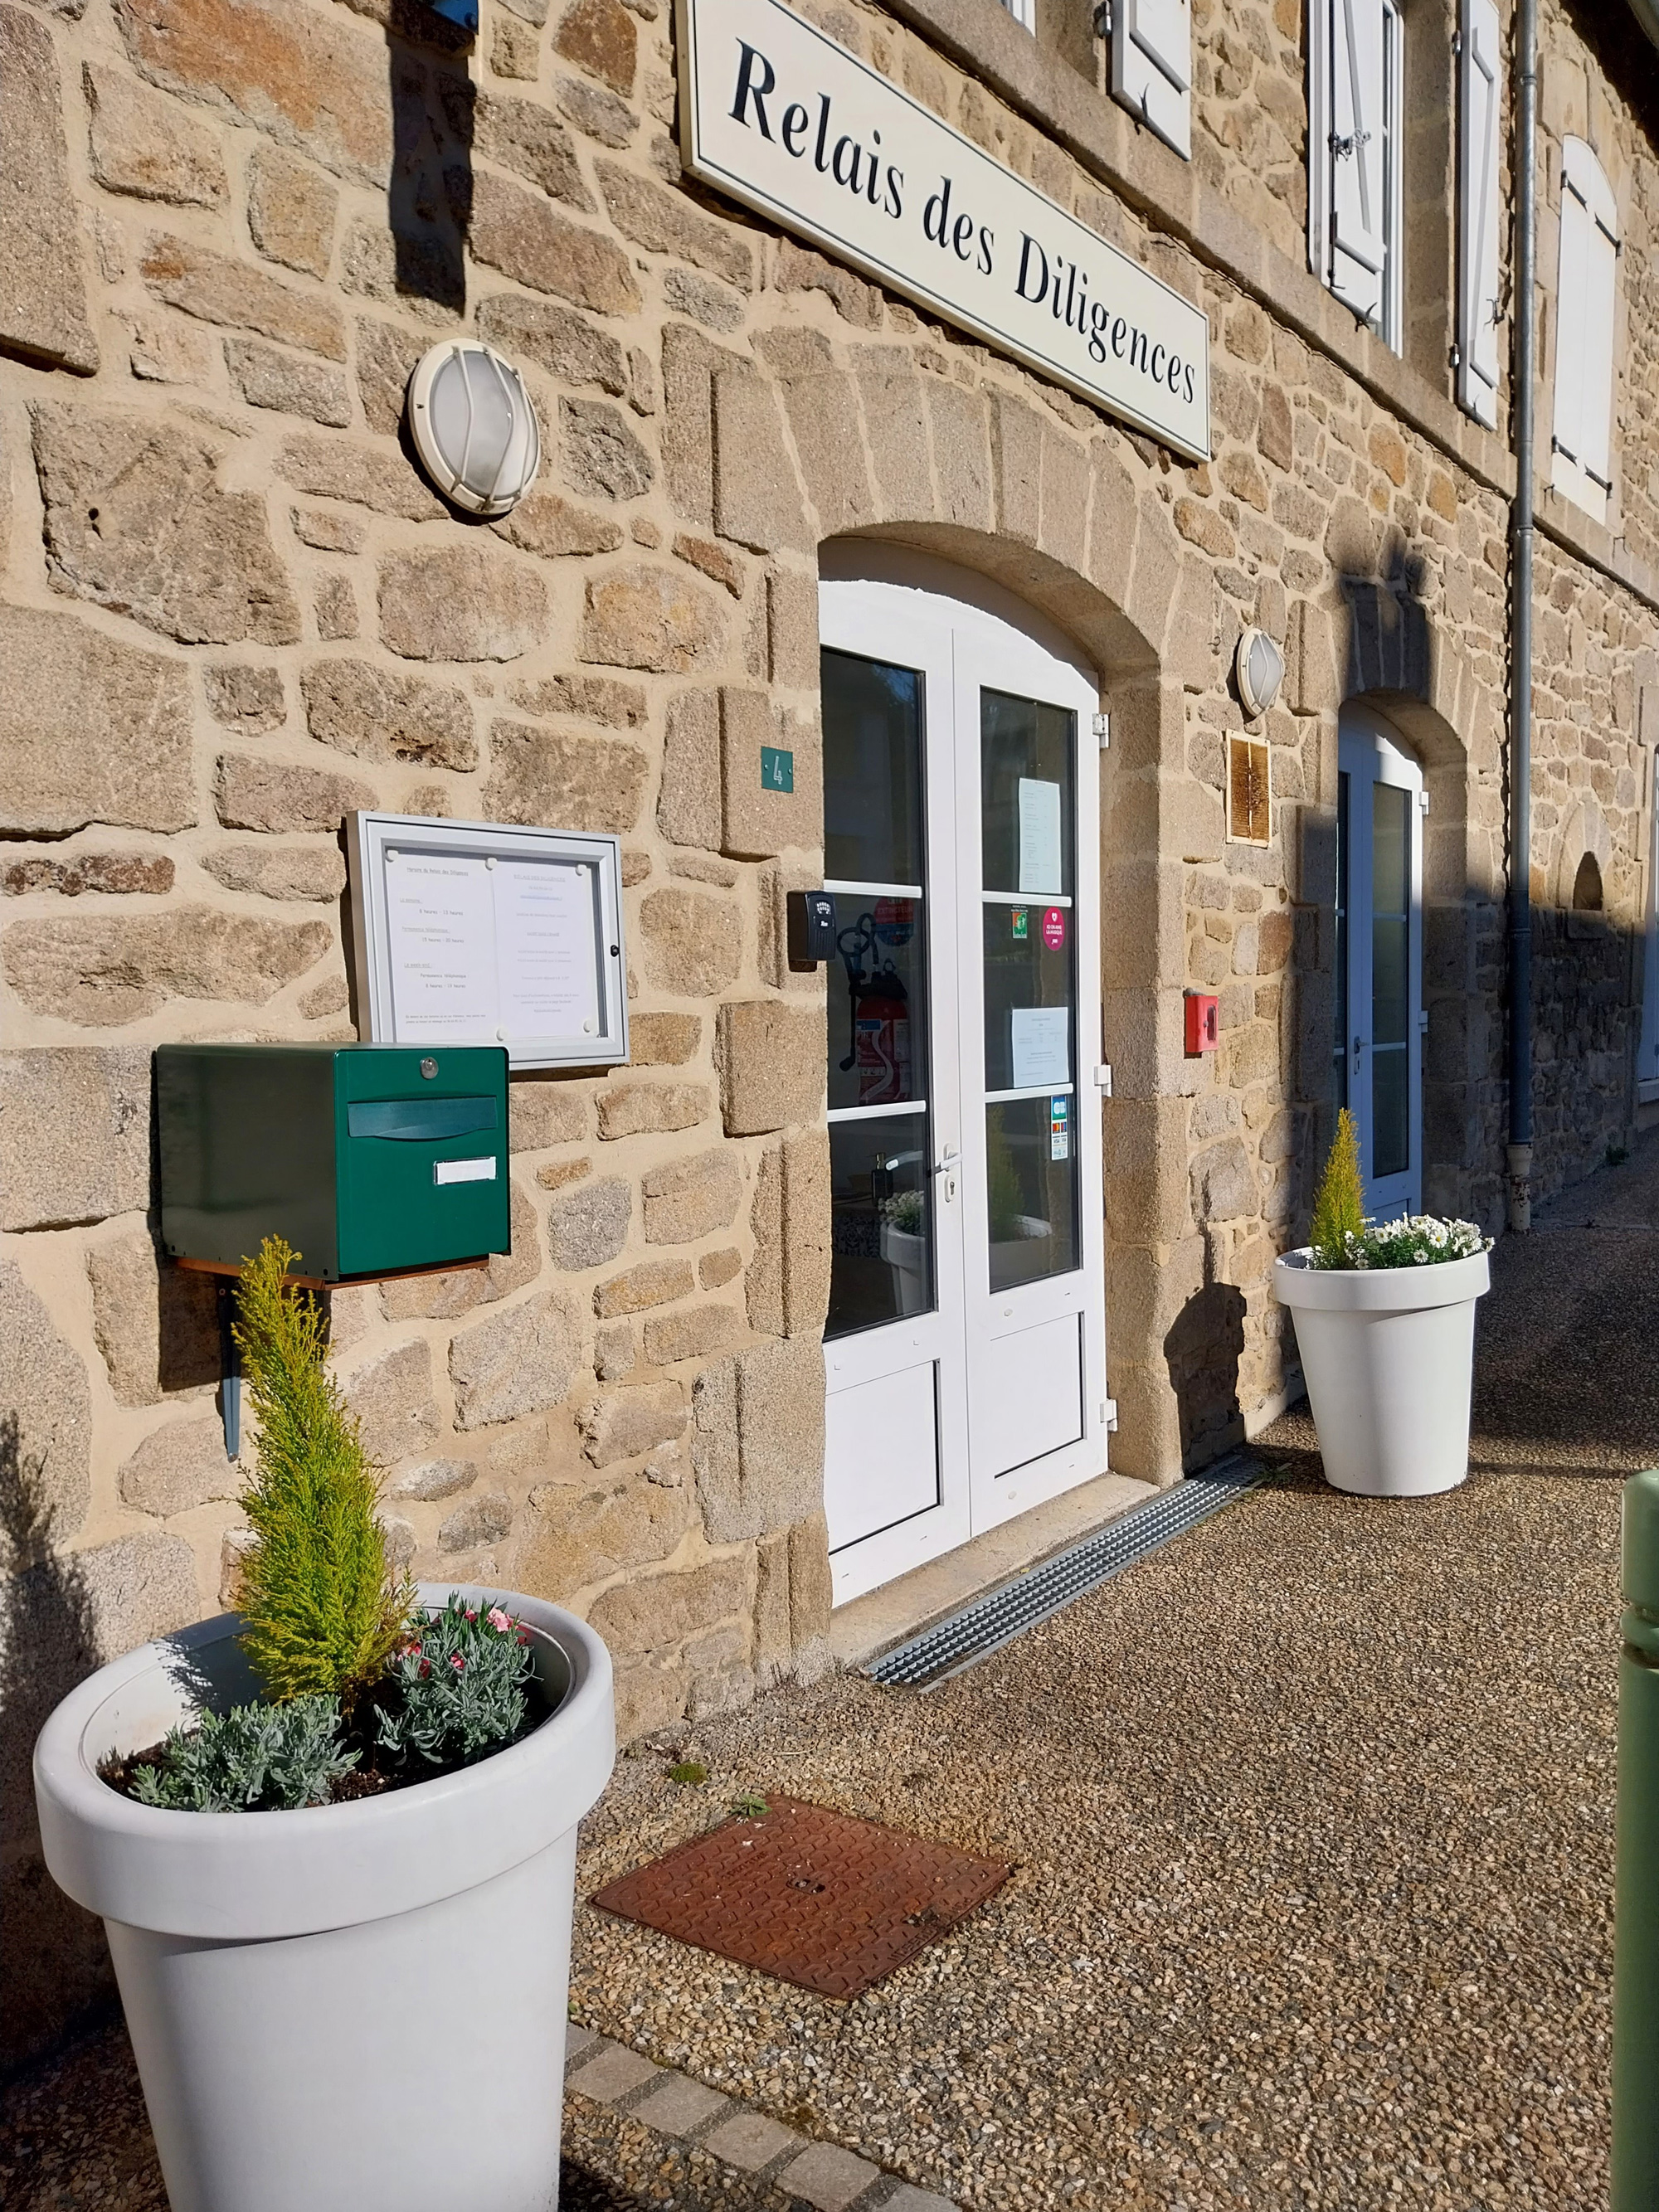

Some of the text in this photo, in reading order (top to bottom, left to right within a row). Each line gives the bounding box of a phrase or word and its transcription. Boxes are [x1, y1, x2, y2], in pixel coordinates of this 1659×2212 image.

[727, 36, 1197, 405] Relais des Diligences
[773, 756, 783, 785] 4
